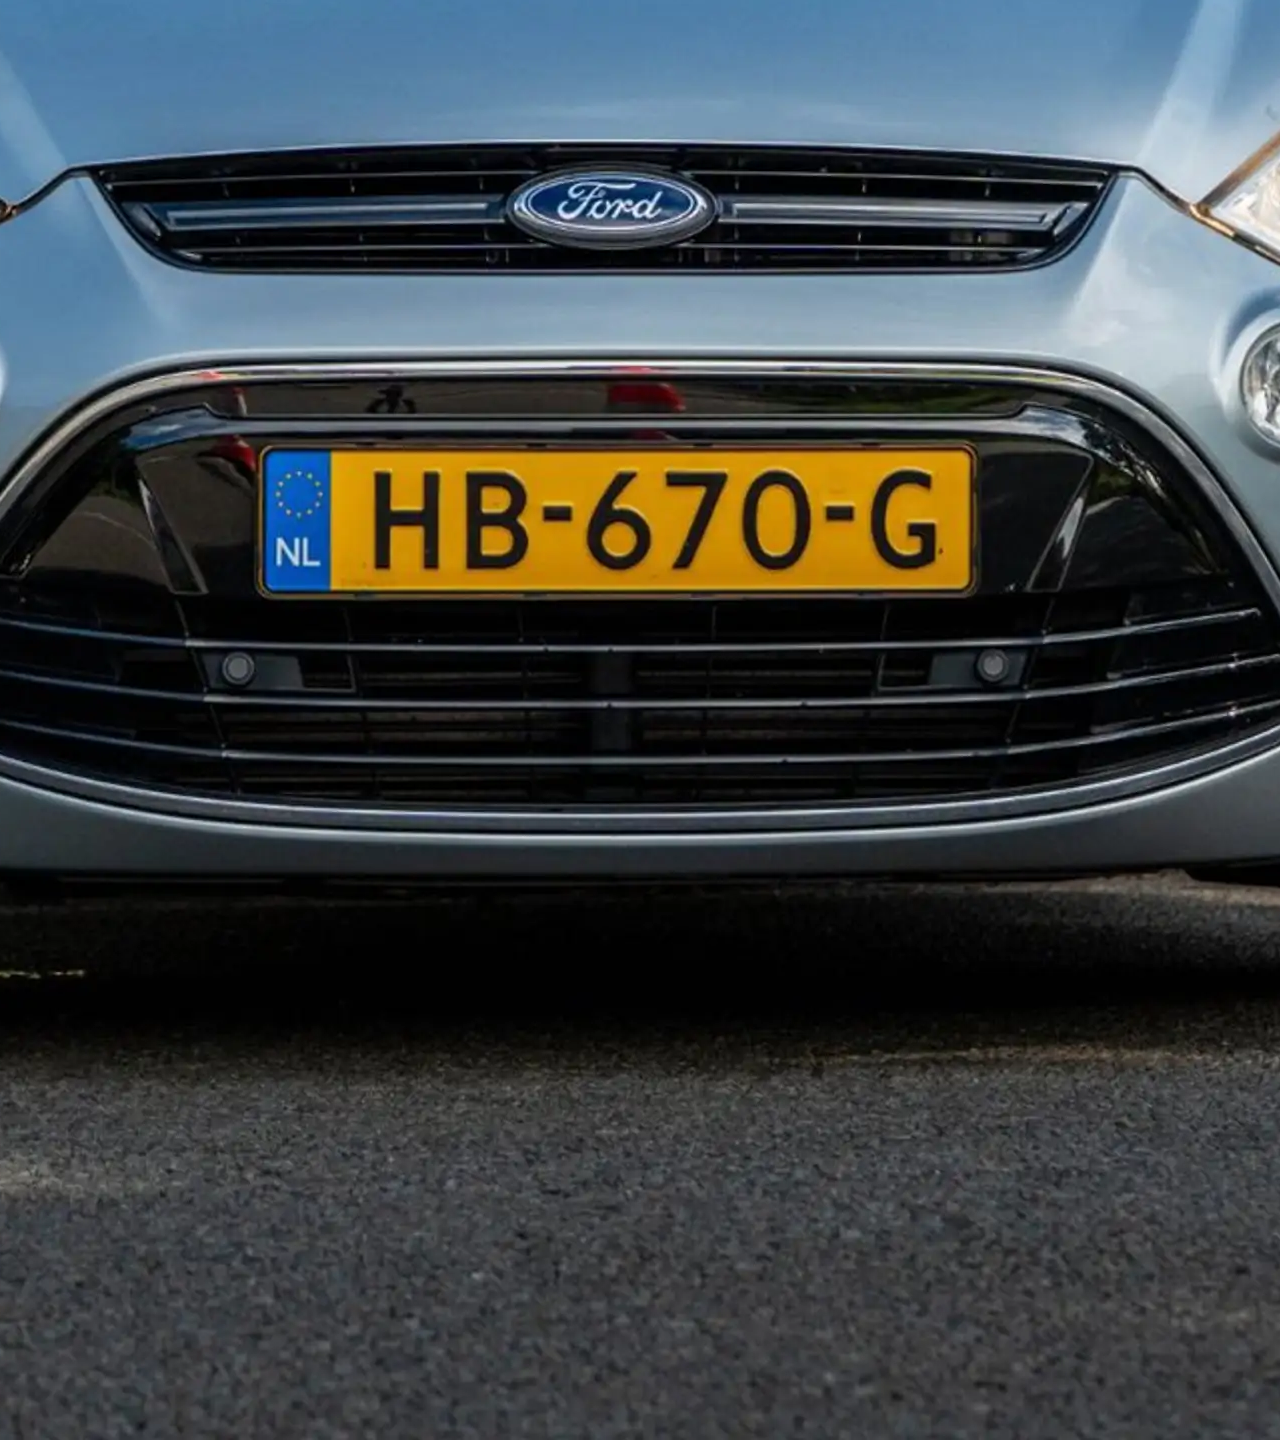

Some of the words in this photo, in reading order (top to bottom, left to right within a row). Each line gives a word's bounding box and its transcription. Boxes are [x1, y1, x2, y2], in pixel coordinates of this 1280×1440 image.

[557, 181, 663, 219] Ford
[373, 468, 938, 570] HB-670-G
[275, 537, 320, 566] NL
